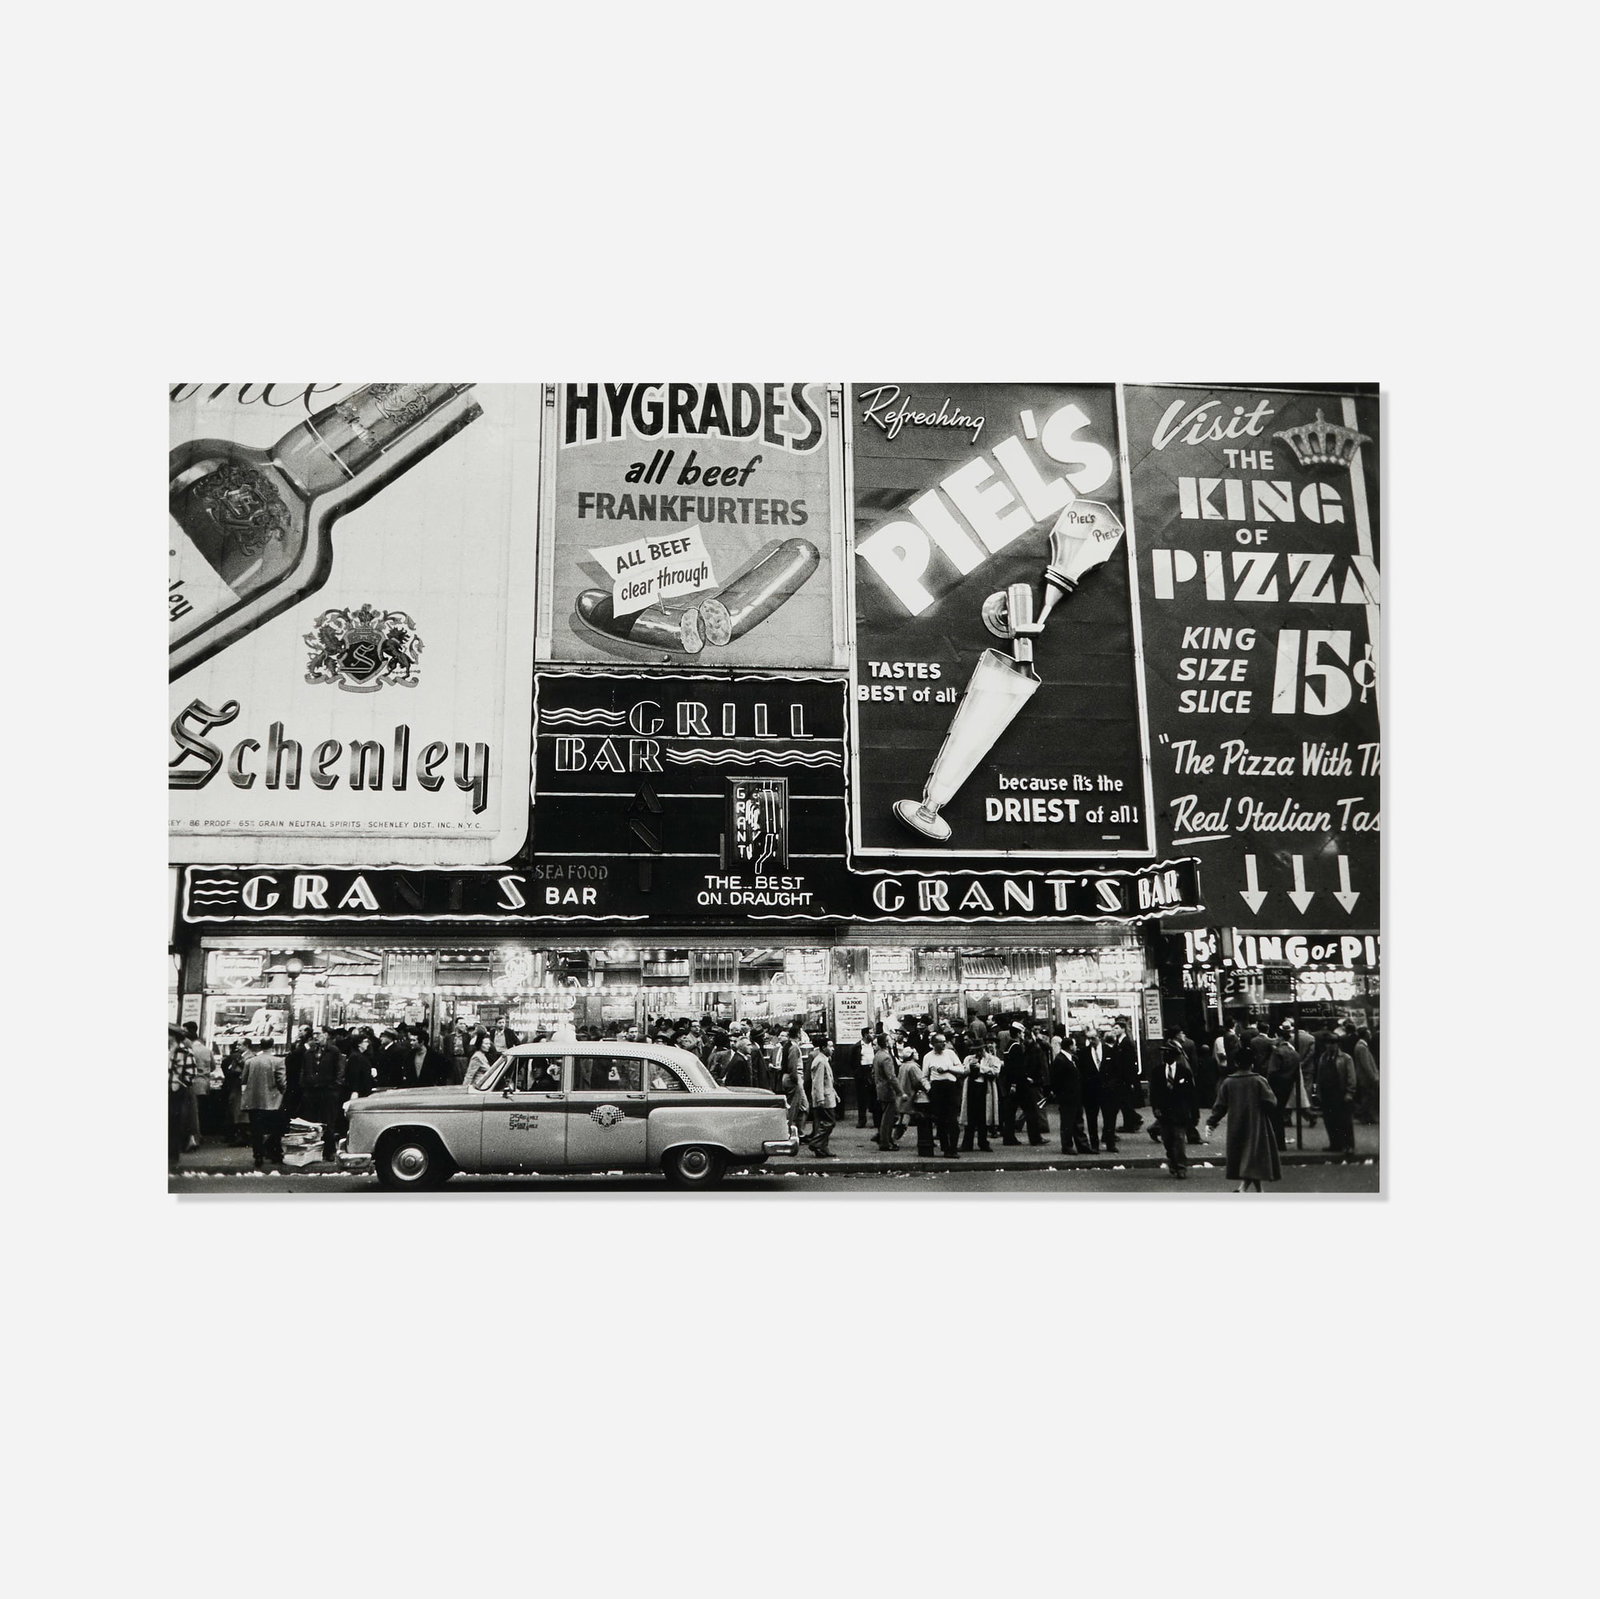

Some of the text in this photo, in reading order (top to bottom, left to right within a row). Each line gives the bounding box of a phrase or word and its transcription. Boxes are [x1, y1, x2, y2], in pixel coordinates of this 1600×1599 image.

[563, 383, 824, 451] HYGRADES
[859, 385, 986, 445] Refreshing
[1152, 399, 1275, 451] Visit
[625, 449, 763, 487] all beef
[1223, 449, 1275, 470] THE
[578, 492, 809, 526] FRANKFURTERS
[855, 403, 1113, 617] PIEL'S
[1178, 476, 1345, 525] KING
[1235, 528, 1268, 545] OF
[616, 537, 691, 574] ALL BEEF
[621, 561, 708, 601] clear through
[1152, 549, 1380, 605] PIZZA
[1181, 626, 1256, 651] KING
[868, 661, 942, 680] TASTES
[1177, 657, 1249, 682] SIZE
[857, 685, 907, 702] BEST
[912, 686, 931, 702] of
[1178, 690, 1252, 714] SLICE
[629, 700, 814, 737] GRILL
[169, 698, 490, 815] Schenley
[556, 738, 664, 772] BAR
[1220, 739, 1295, 776] Pizza
[1302, 741, 1353, 777] With
[1000, 774, 1068, 790] because
[1097, 775, 1123, 791] the
[259, 820, 284, 828] GRAIN
[289, 820, 327, 828] NEUTRAL
[368, 821, 409, 829] SCHENLEY
[985, 797, 1080, 823] DRIEST
[1086, 806, 1104, 823] of
[1170, 794, 1232, 832] Real
[1235, 796, 1331, 832] Italian
[545, 887, 597, 905] BAR
[698, 891, 813, 905] ON DRAUGHT
[704, 876, 804, 890] THE BEST
[873, 879, 1122, 912] GRANT'S
[1138, 870, 1182, 910] BAR
[1232, 927, 1380, 969] KING OF PI
